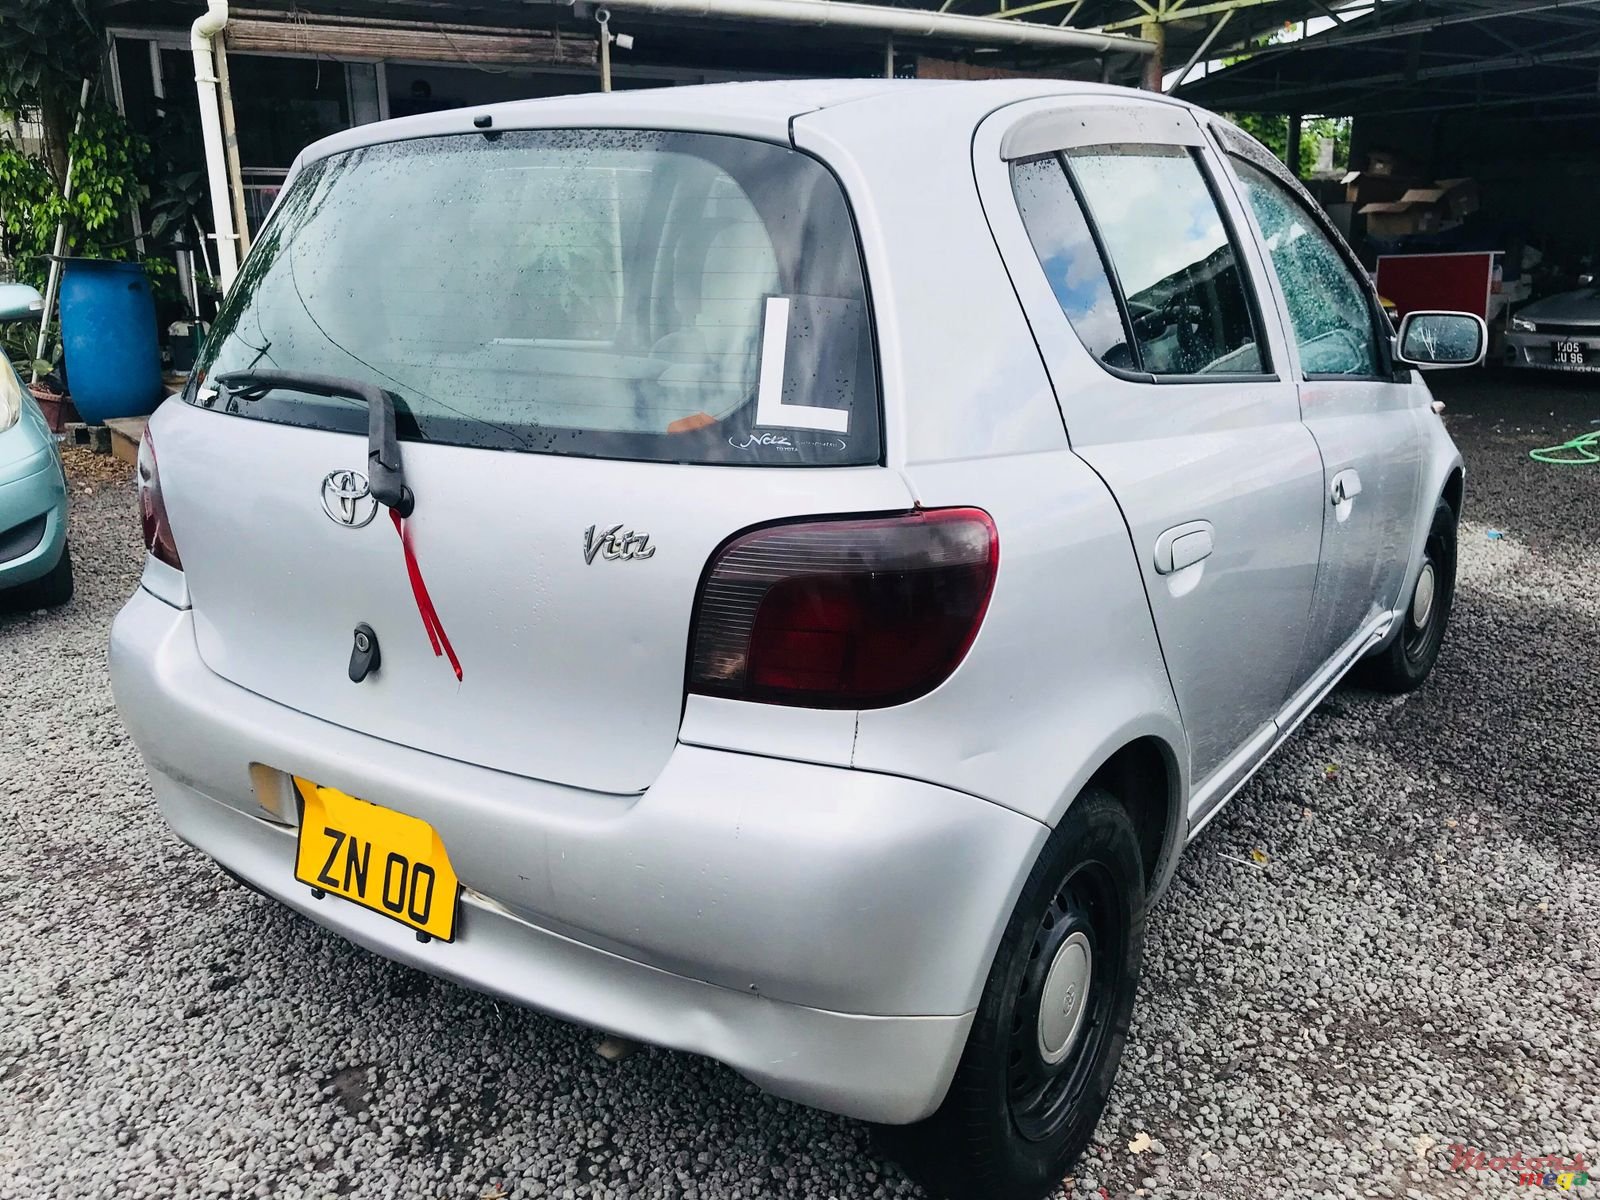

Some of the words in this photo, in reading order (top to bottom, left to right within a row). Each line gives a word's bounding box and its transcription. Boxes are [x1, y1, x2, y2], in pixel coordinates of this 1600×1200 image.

[756, 297, 849, 433] L
[1570, 353, 1583, 364] 96
[583, 523, 656, 566] Vitz
[317, 826, 371, 898] ZN
